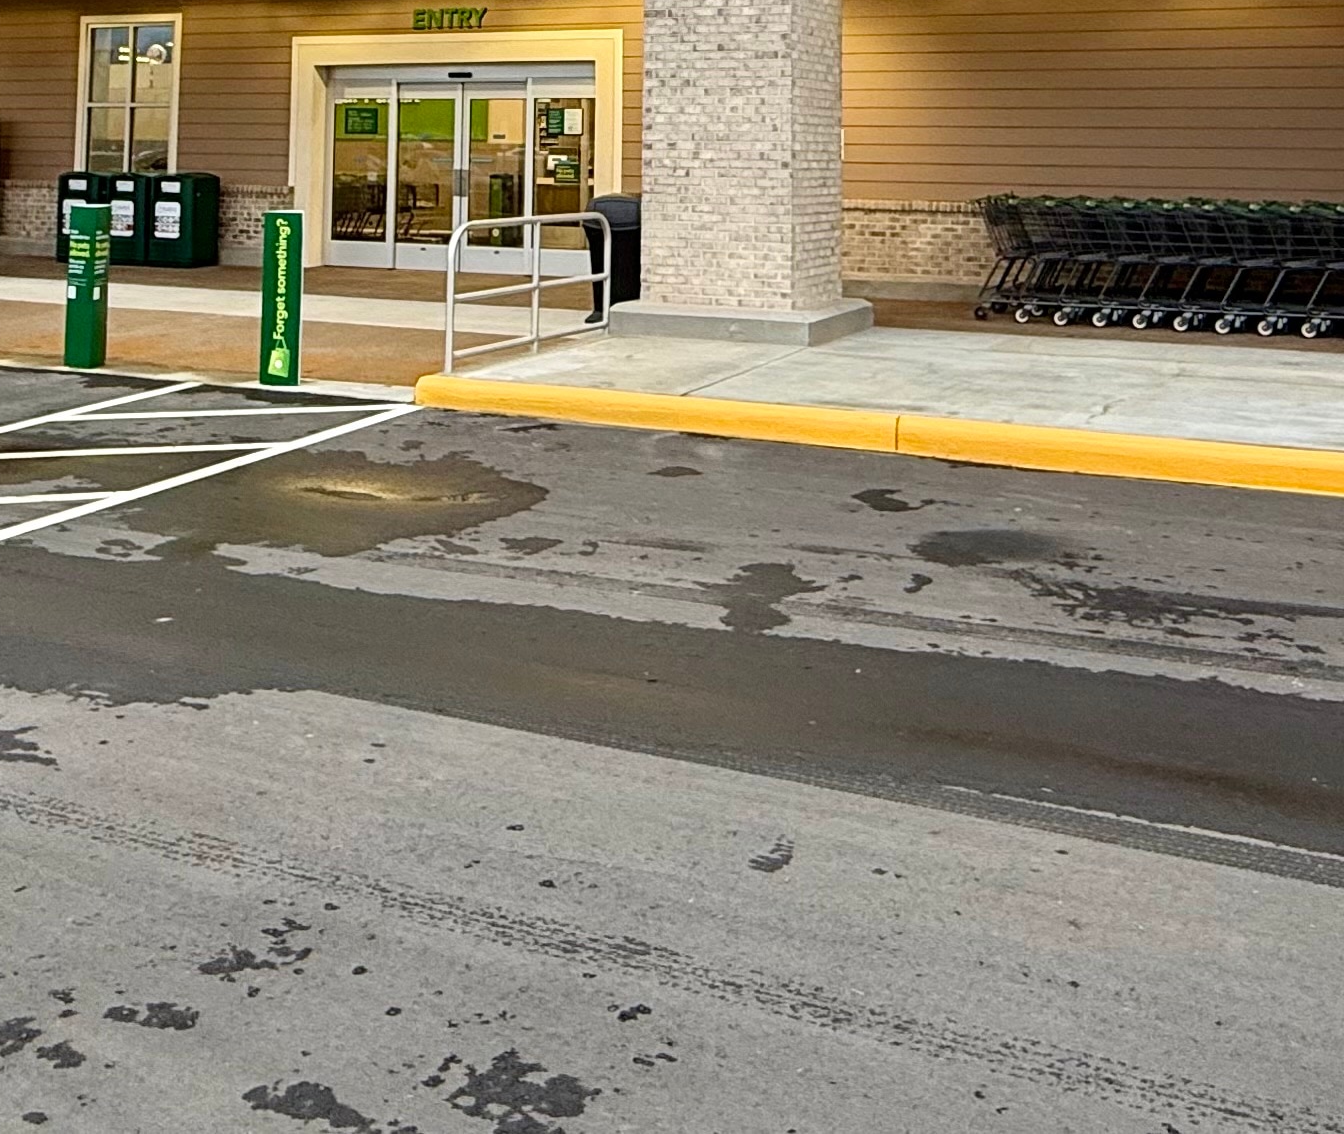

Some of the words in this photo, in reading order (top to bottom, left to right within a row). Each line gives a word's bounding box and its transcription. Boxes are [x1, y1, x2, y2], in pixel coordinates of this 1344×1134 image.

[413, 7, 487, 30] ENTRY
[276, 218, 291, 294] something?
[273, 296, 289, 339] Forget
